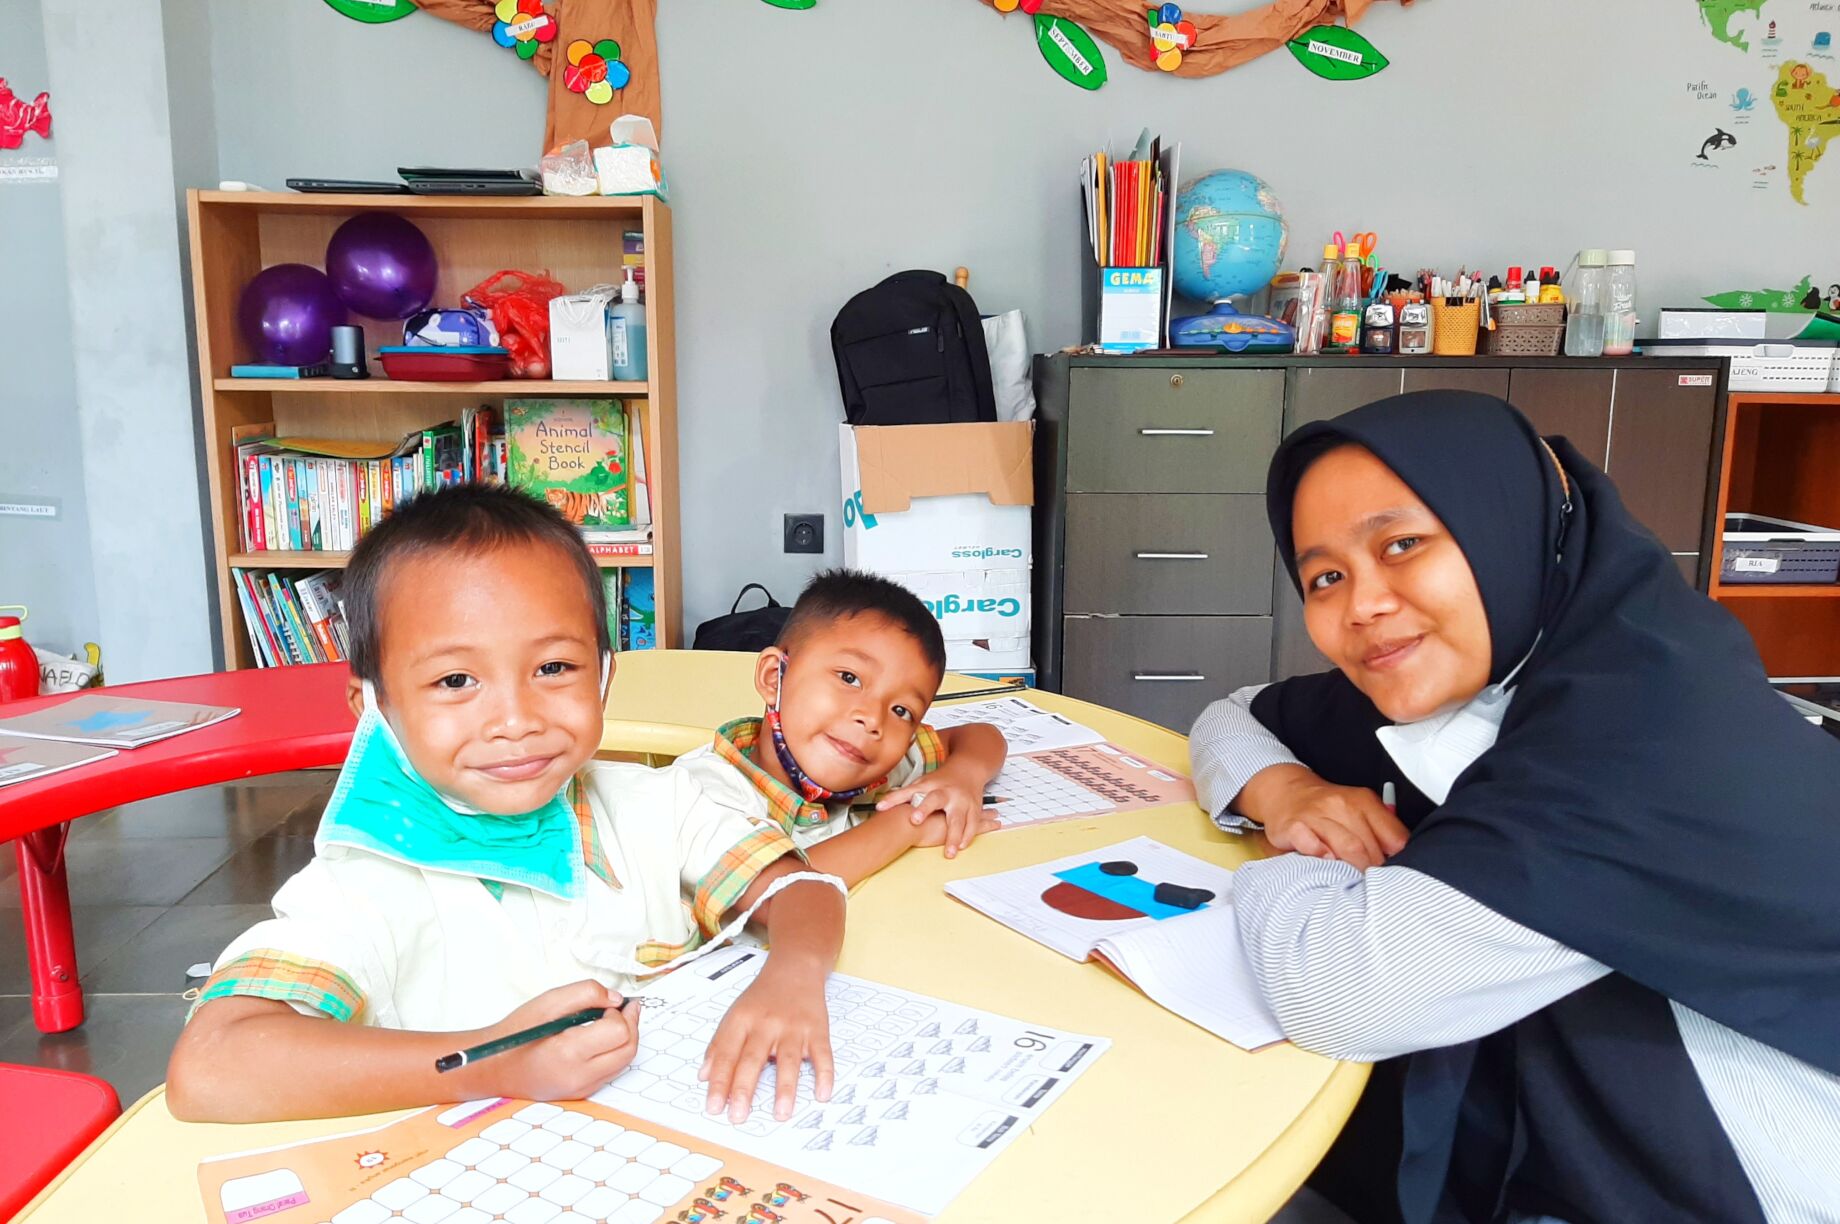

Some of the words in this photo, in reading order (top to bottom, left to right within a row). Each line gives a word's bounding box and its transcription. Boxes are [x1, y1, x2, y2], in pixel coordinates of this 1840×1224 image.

[1312, 42, 1360, 63] NOVEMBER
[1110, 272, 1154, 286] GEMA
[1732, 367, 1758, 376] AJENG
[536, 421, 593, 438] Animal
[540, 440, 590, 454] Stencil
[549, 456, 586, 471] Book
[589, 545, 634, 554] ALPHABET
[952, 547, 1022, 560] Cargloss
